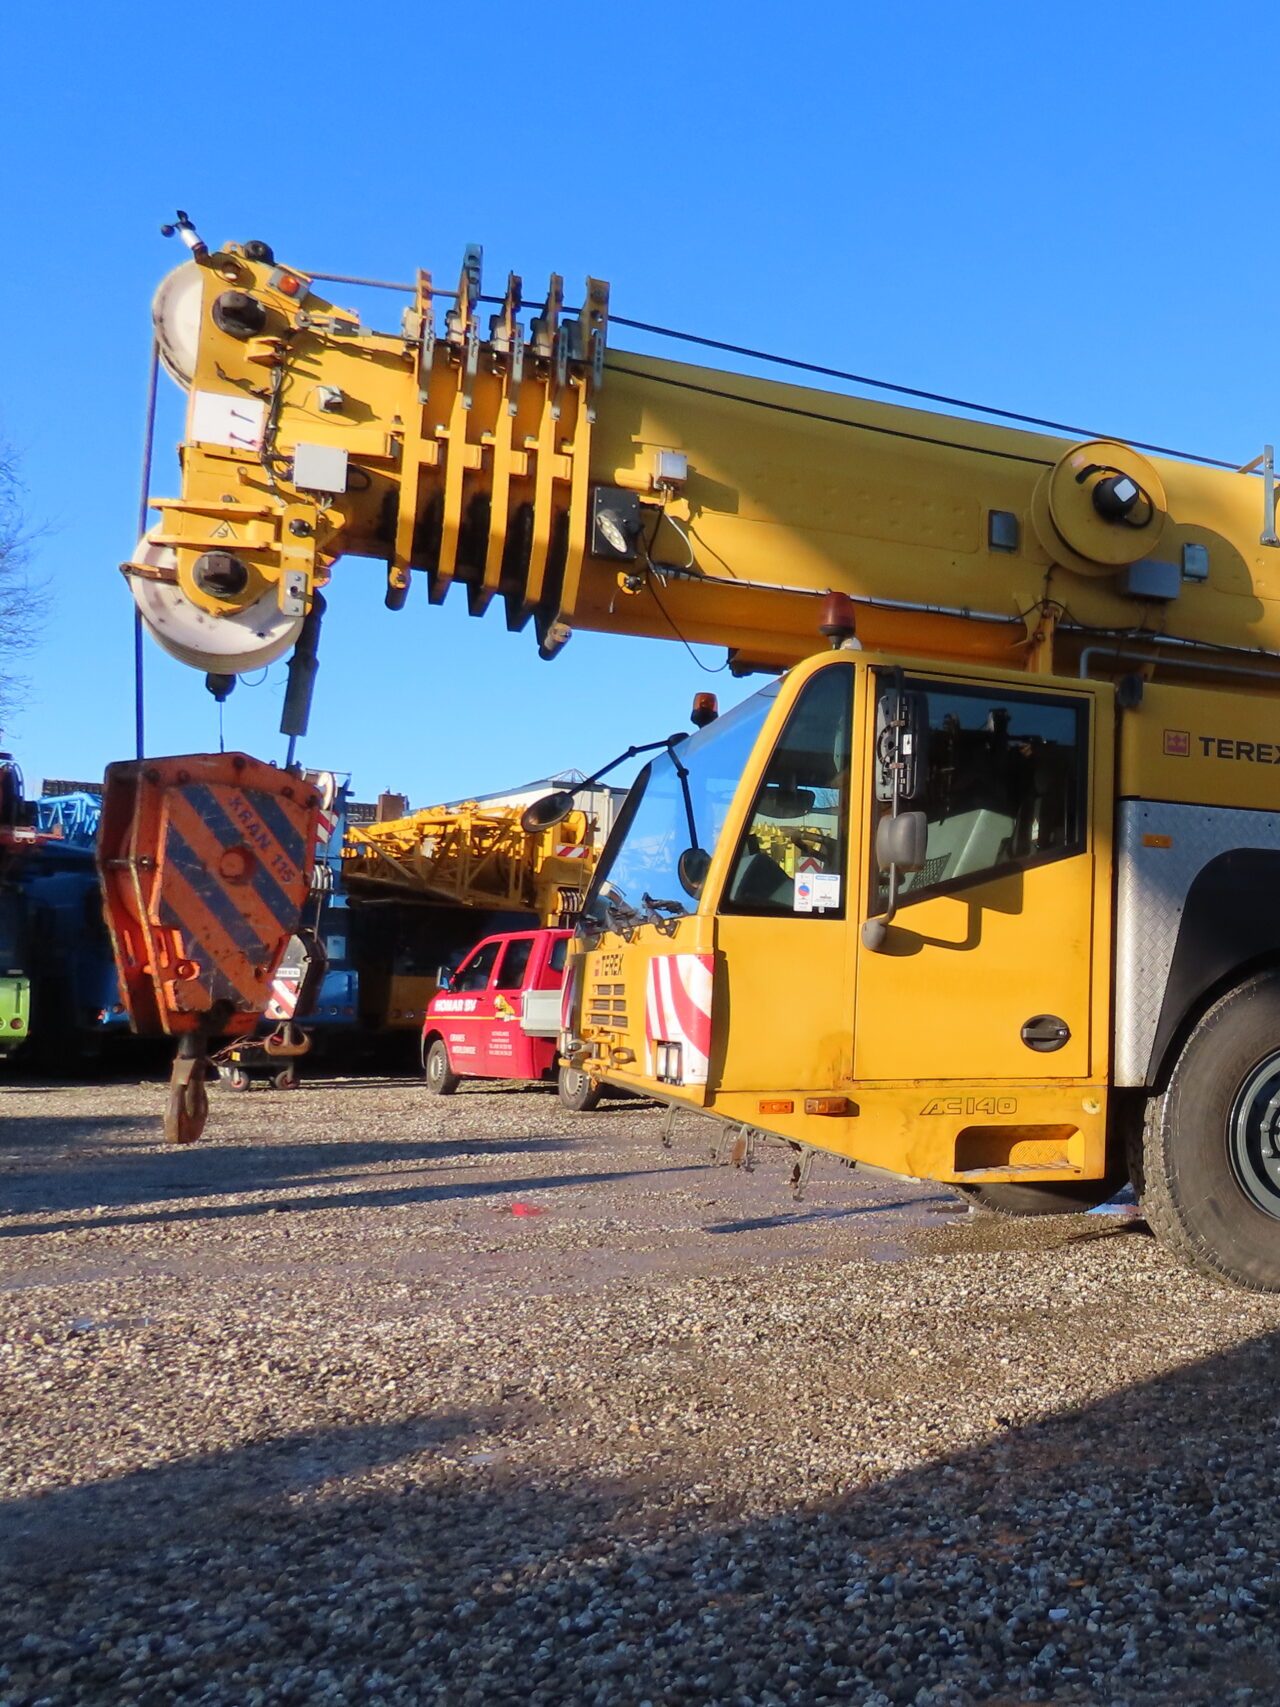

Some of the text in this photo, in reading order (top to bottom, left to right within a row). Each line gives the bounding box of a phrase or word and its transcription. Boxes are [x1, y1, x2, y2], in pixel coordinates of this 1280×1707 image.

[228, 797, 272, 851] KRAN
[601, 953, 625, 977] TEREX
[464, 999, 478, 1012] BV
